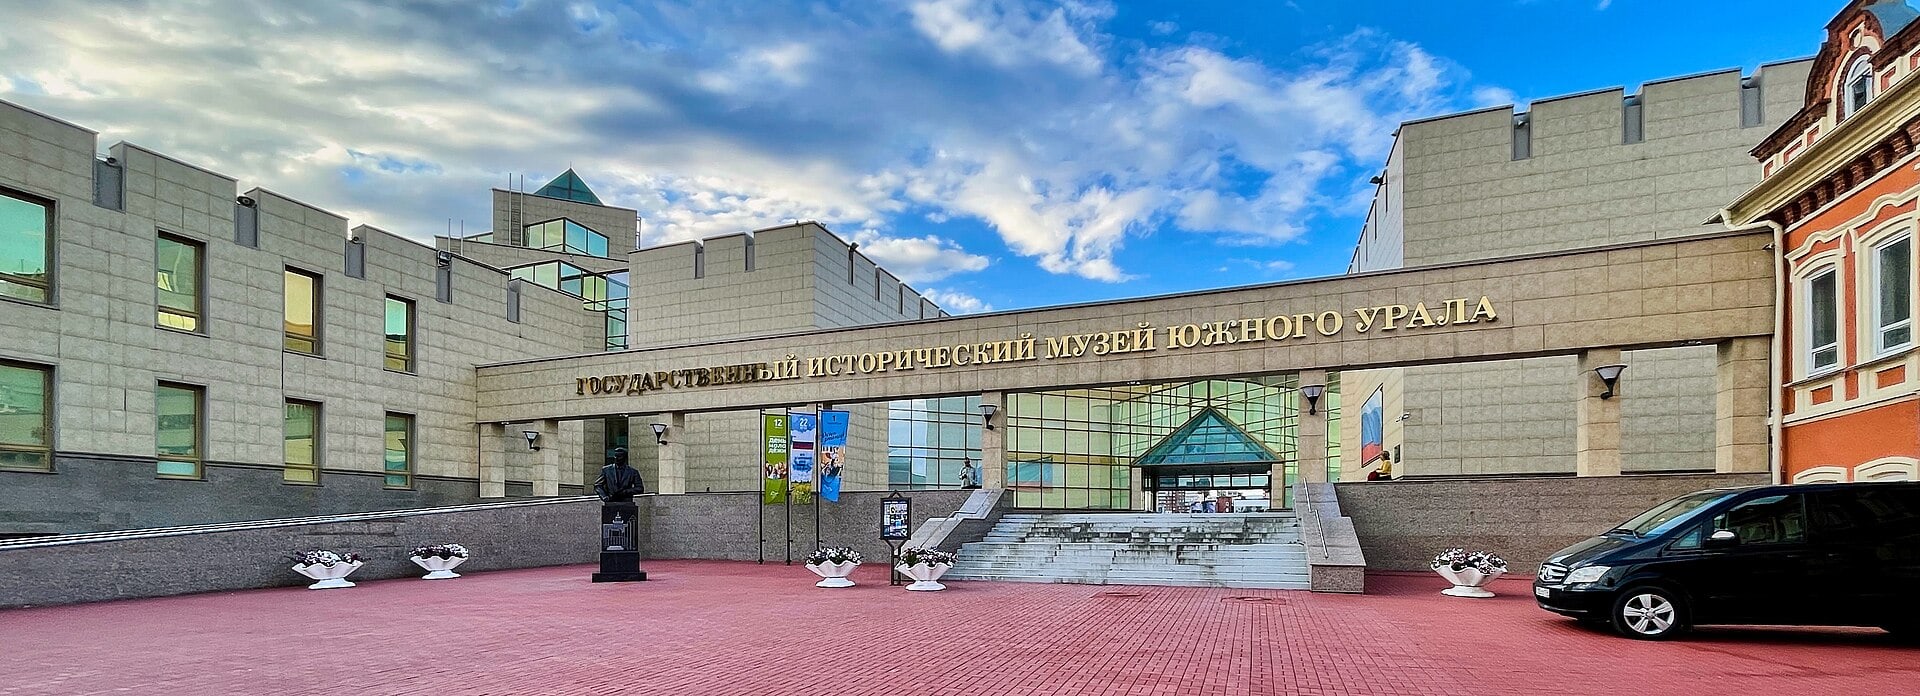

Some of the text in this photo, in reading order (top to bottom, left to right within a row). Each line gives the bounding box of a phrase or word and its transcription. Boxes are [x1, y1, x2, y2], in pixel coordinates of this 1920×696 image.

[576, 295, 1498, 396] ГОСУДАРСТВЕННЫЙ ИСТОРИЧЕСКИЙ МУЗЕЙ ЮЖНОГО УРАЛА
[774, 418, 783, 427] 12
[799, 418, 808, 427] 22
